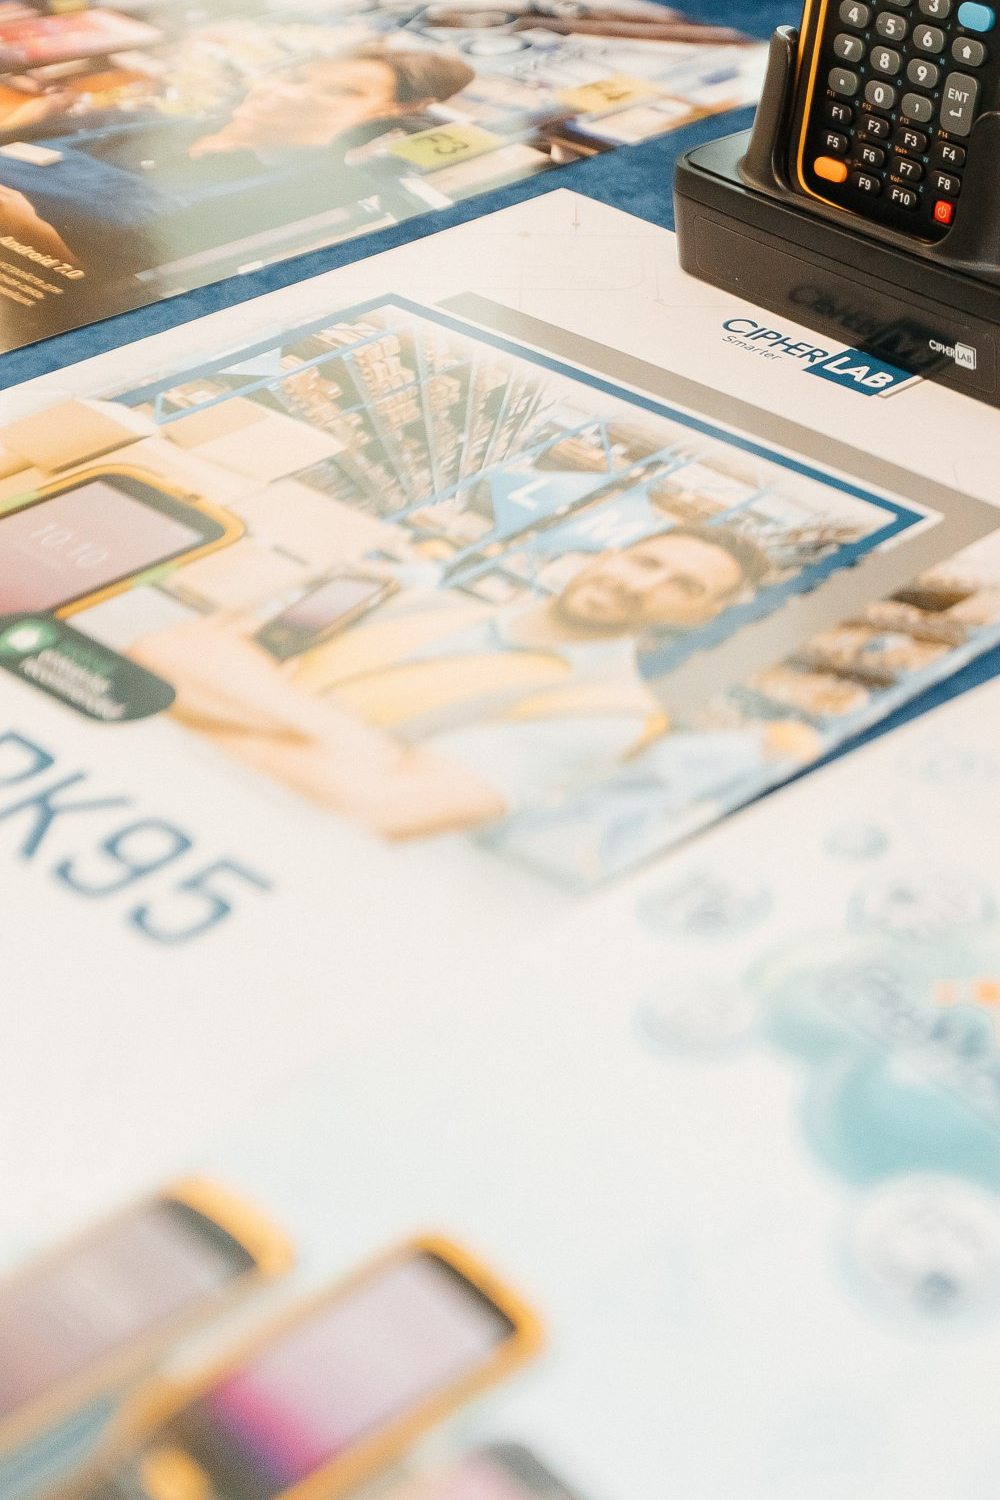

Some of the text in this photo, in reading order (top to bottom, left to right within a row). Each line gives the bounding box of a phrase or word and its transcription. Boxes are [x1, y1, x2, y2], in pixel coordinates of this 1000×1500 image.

[848, 7, 858, 22] 4
[885, 18, 896, 34] 5
[922, 31, 933, 47] 6
[843, 40, 854, 55] 7
[880, 52, 890, 68] 8
[917, 65, 928, 81] 9
[874, 87, 884, 103] 0
[948, 88, 969, 103] ENT
[832, 106, 843, 120] F1
[862, 102, 872, 111] F12
[868, 120, 880, 134] F2
[827, 135, 839, 148] F5
[904, 133, 917, 147] F3
[863, 148, 875, 162] F6
[942, 146, 956, 160] F4
[900, 162, 913, 175] F7
[858, 177, 871, 190] F9
[938, 176, 950, 190] F8
[892, 189, 910, 206] F10
[0, 236, 60, 268] Android
[54, 262, 86, 280] 7.0
[722, 335, 782, 360] Smarter
